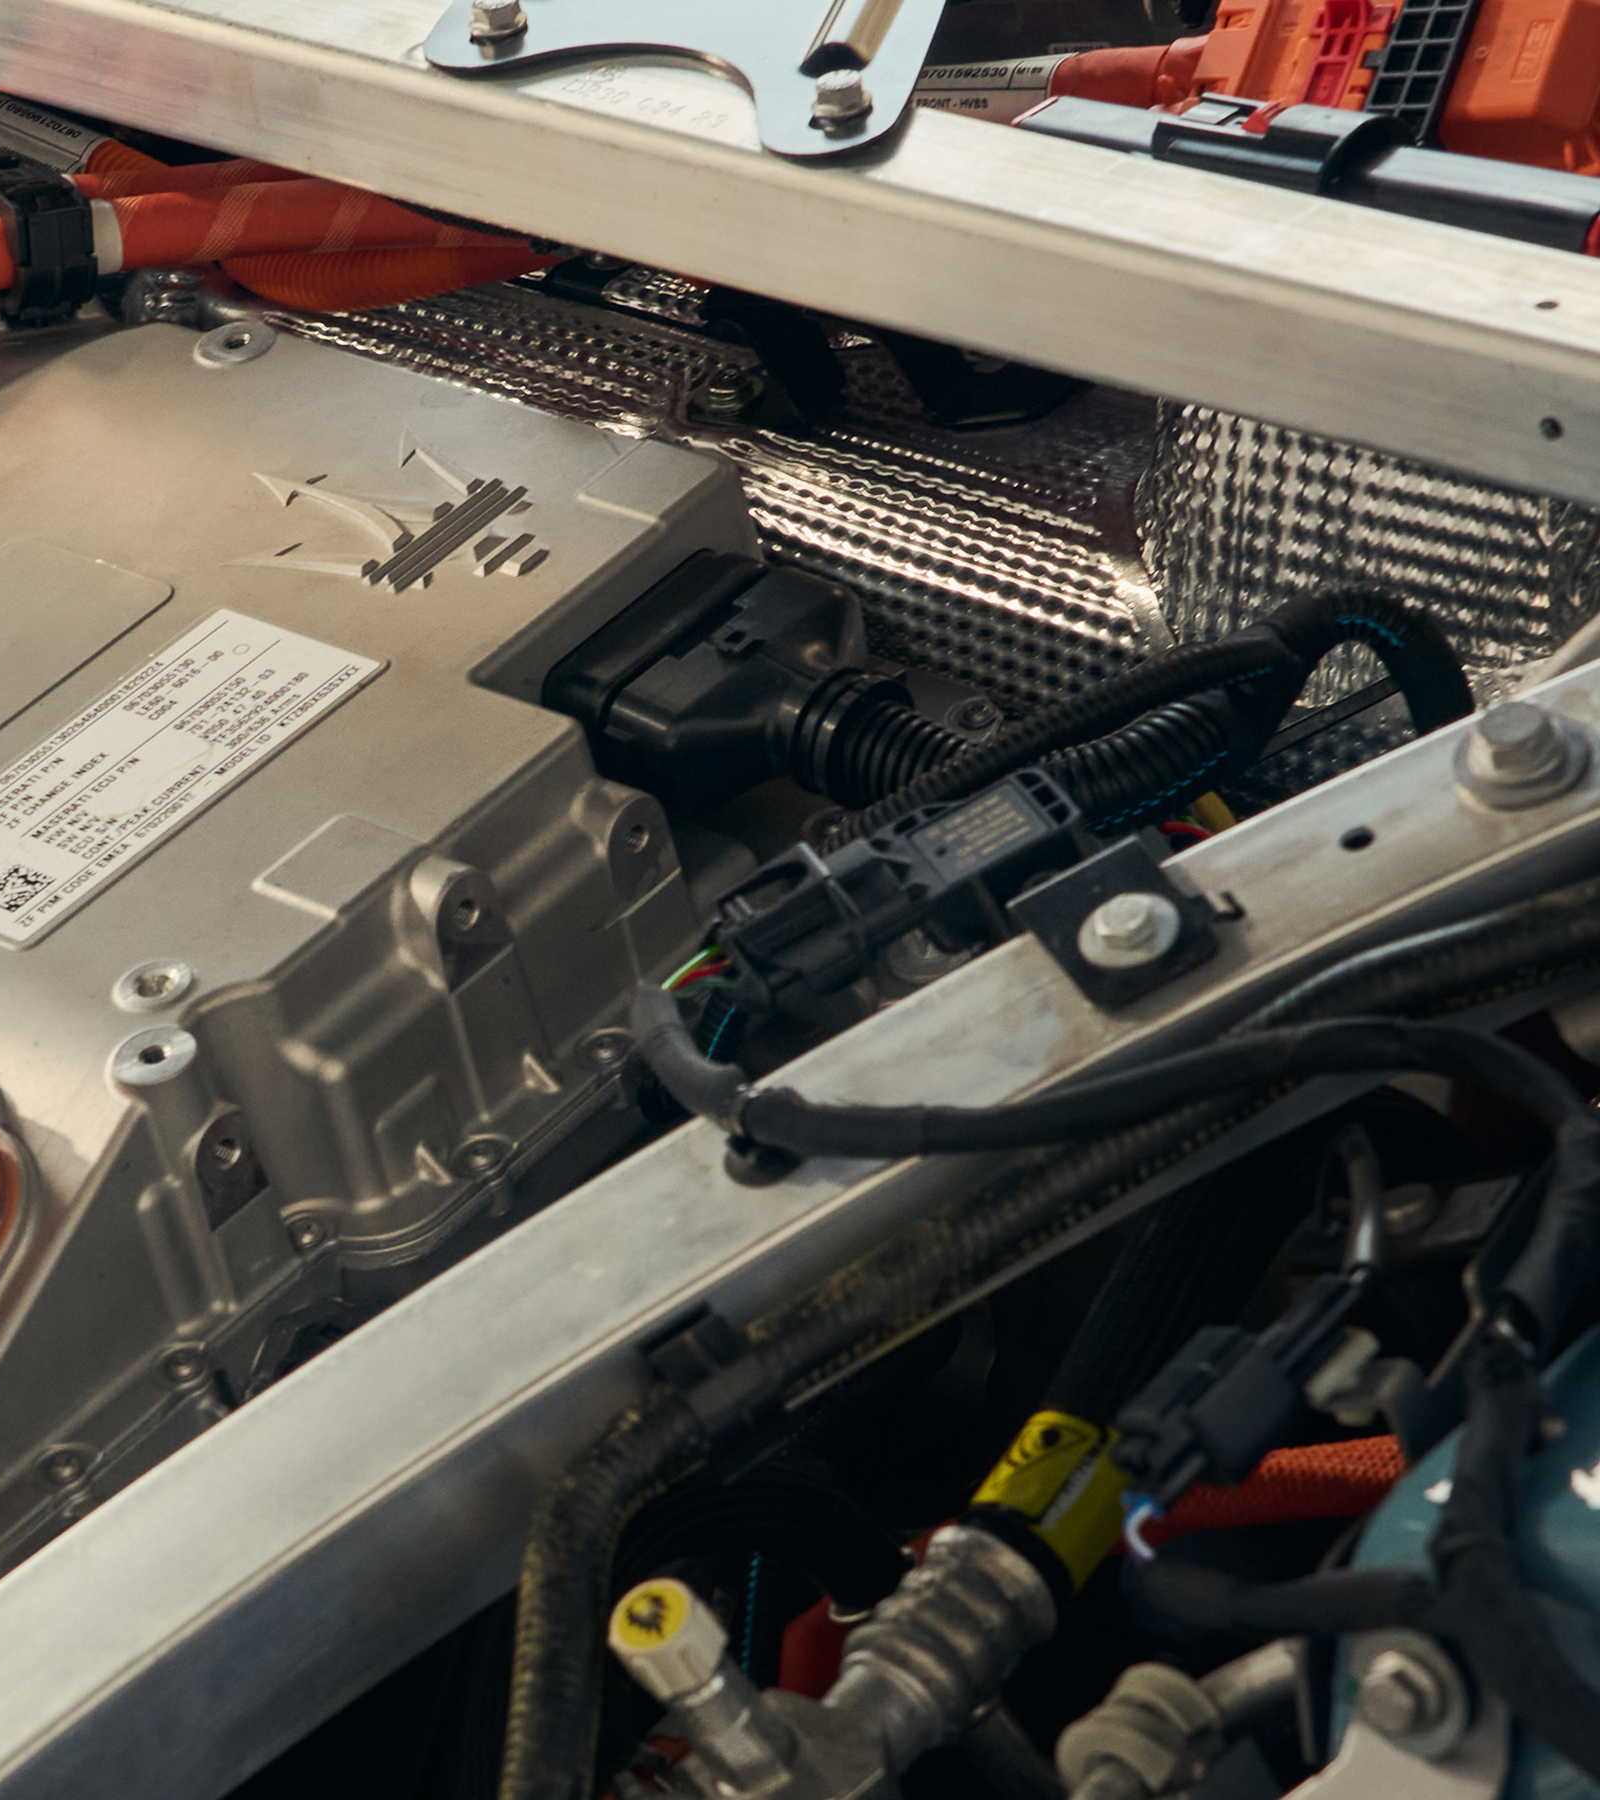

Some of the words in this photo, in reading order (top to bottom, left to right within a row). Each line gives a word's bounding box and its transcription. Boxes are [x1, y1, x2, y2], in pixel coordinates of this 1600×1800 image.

[39, 757, 65, 773] P/N
[3, 816, 24, 829] ZF
[20, 779, 73, 816] CHANGE
[69, 751, 110, 779] INDEX
[8, 793, 36, 811] P/N
[29, 793, 92, 839] MASERATI
[90, 774, 118, 792] ECU
[115, 756, 141, 773] P/N
[149, 763, 208, 806] CURRENT
[17, 914, 38, 927] ZF
[61, 868, 98, 894] CODE
[94, 842, 132, 868] EMEA
[213, 745, 257, 776] MODEL
[253, 733, 273, 744] ID
[42, 827, 68, 844] HW
[54, 832, 81, 850] SW
[67, 835, 96, 854] ECU
[93, 817, 120, 834] S/N
